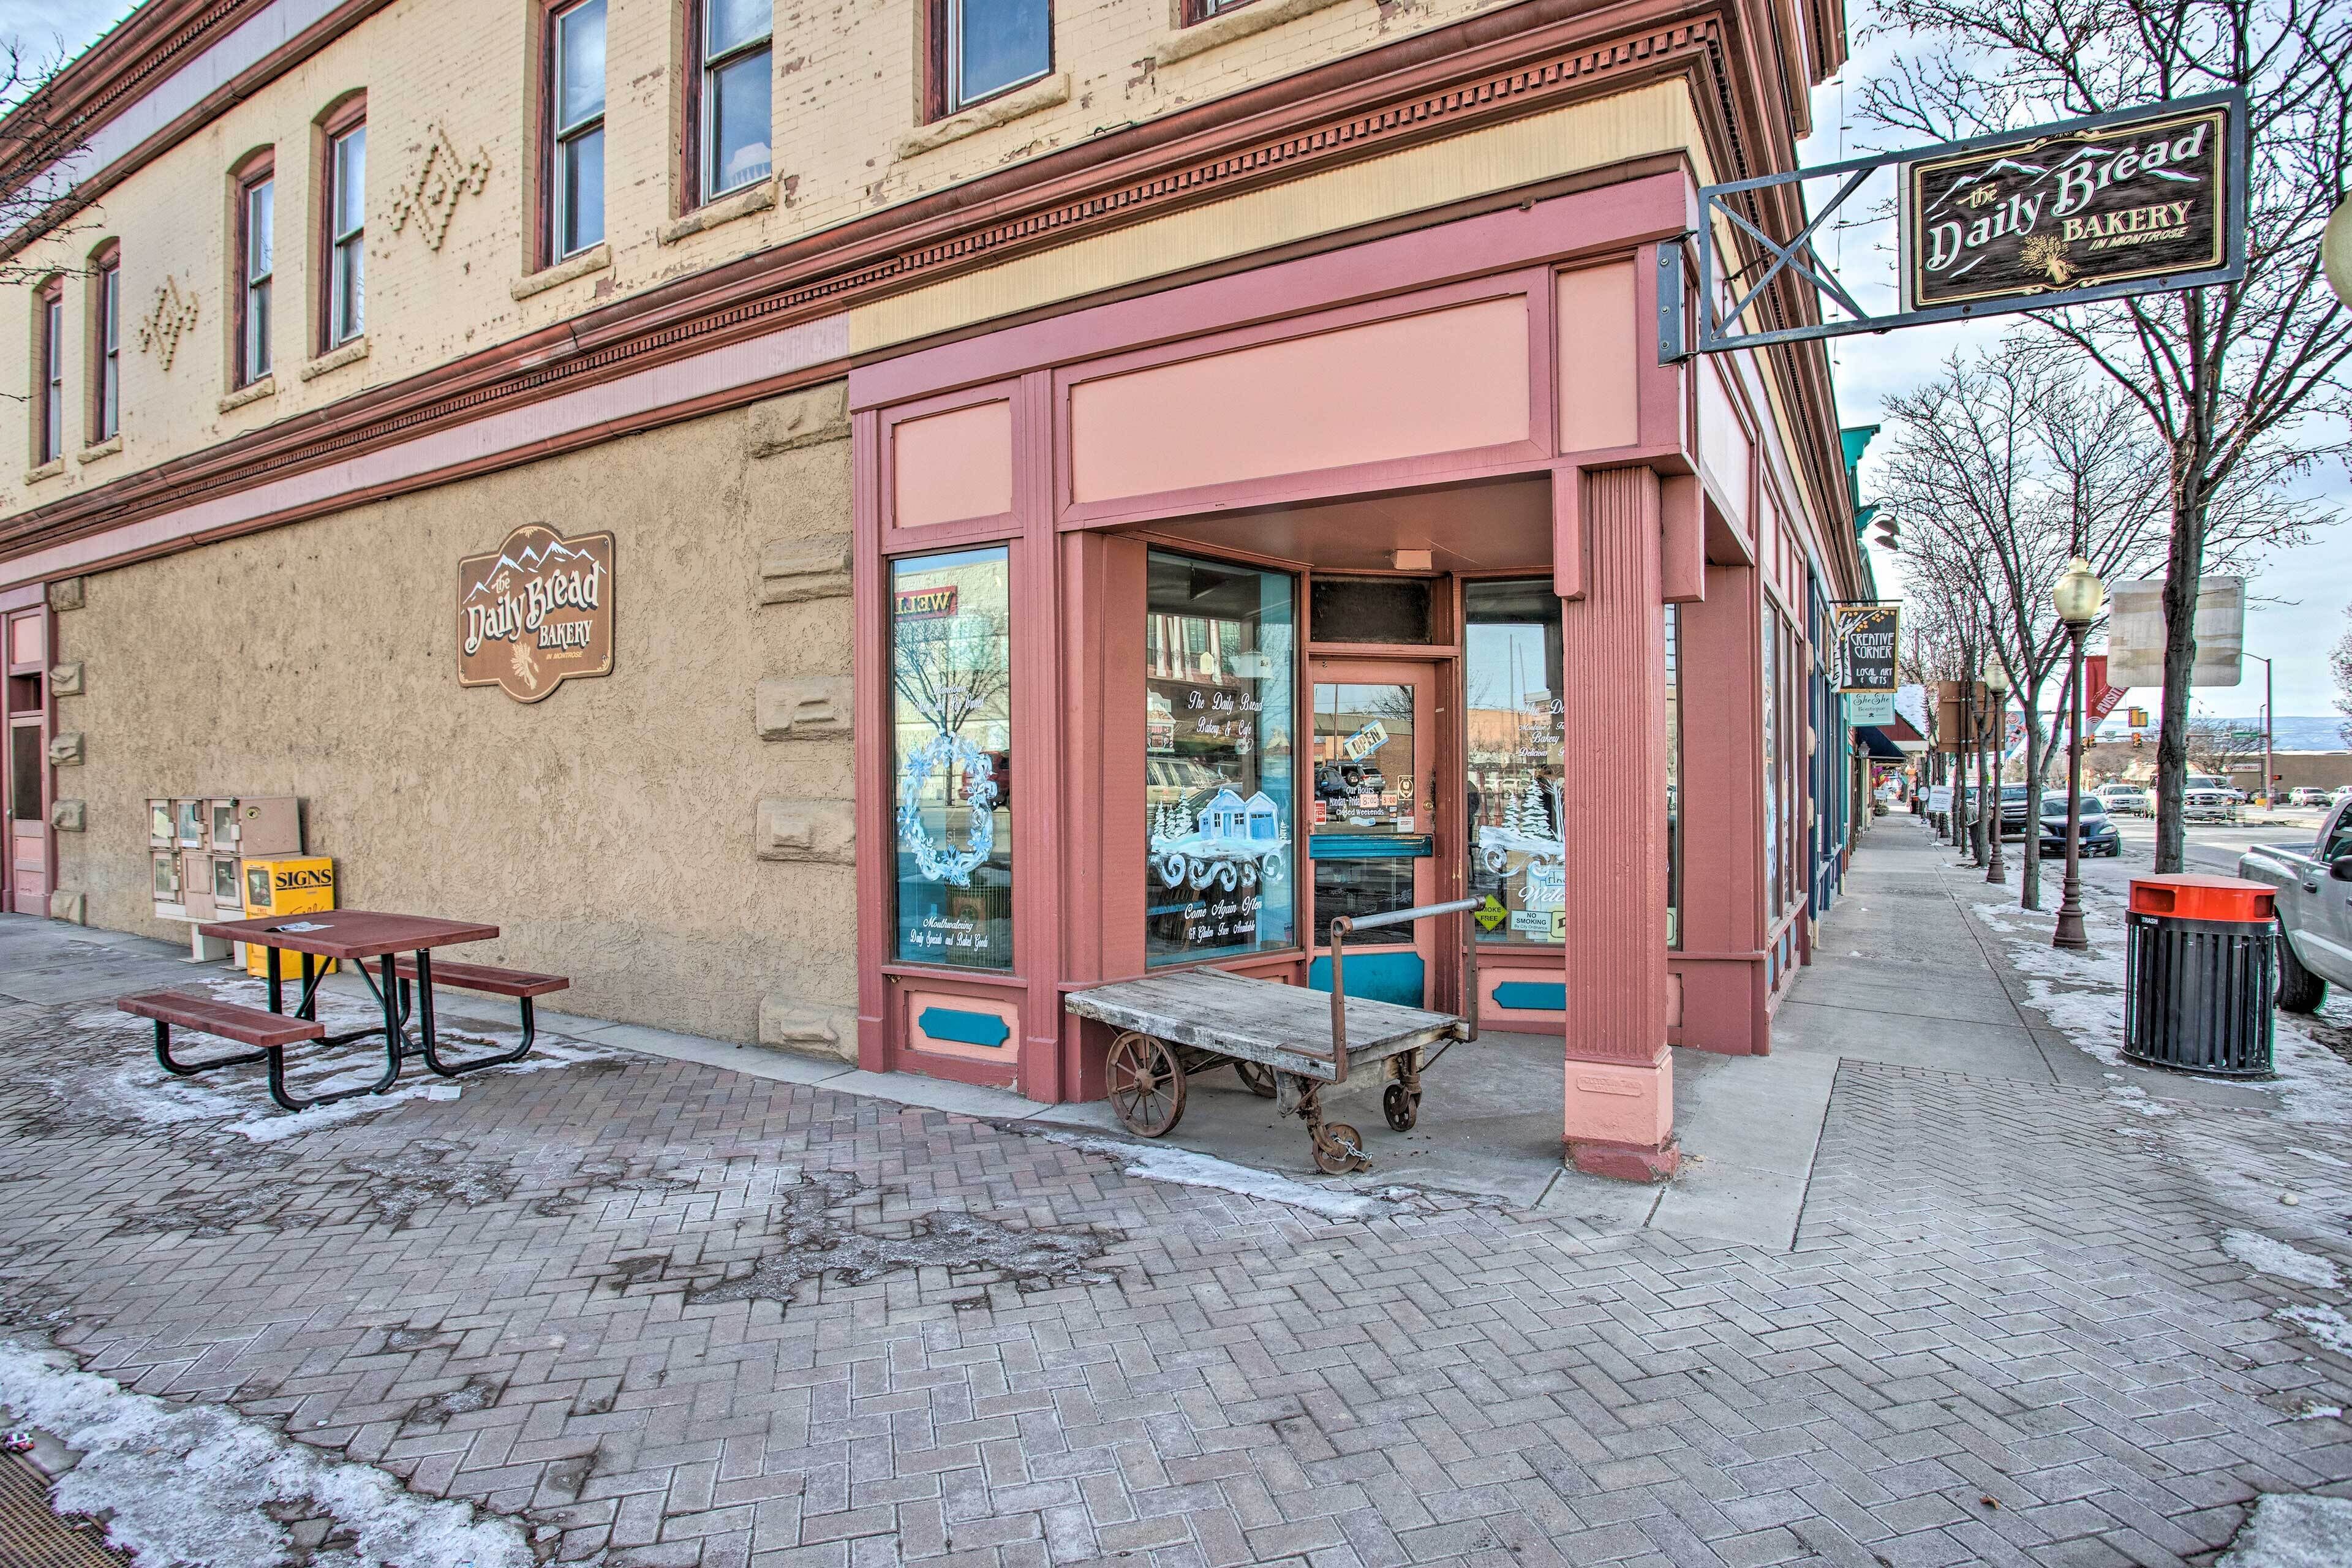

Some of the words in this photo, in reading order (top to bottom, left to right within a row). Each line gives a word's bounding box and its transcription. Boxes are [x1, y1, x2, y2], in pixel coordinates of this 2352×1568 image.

[1925, 191, 2046, 271] Daily
[2050, 123, 2208, 217] Bread
[1957, 183, 1998, 208] the
[2062, 199, 2196, 243] BAKERY
[2088, 238, 2108, 251] IN
[2107, 226, 2190, 248] MONTROSE
[491, 570, 511, 594] the
[464, 591, 526, 654] Daily
[525, 560, 600, 630] Bread
[538, 620, 593, 649] BAKERY
[1850, 633, 1894, 646] CREATIVE
[552, 651, 583, 660] MONTROSE
[1855, 646, 1892, 658] CORNER
[1869, 676, 1887, 685] GIFTS
[1188, 691, 1205, 709] The
[1212, 692, 1234, 715] Daily
[1240, 693, 1264, 712] Bread
[1520, 700, 1540, 716] The
[1196, 716, 1219, 738] Bakery
[1224, 721, 1231, 736] &
[1238, 719, 1251, 739] Cafe
[1352, 726, 1382, 755] OPEN
[1531, 731, 1560, 746] Bakery
[1519, 747, 1548, 757] Delicious
[1329, 796, 1346, 807] Monday
[1349, 796, 1360, 807] Frida
[1363, 797, 1377, 805] 8:00
[276, 869, 332, 888] SIGNS
[1185, 903, 1207, 919] Come
[1212, 899, 1237, 919] Again
[1242, 895, 1262, 916] Often
[923, 916, 973, 933] Mouthwatering
[1218, 922, 1229, 936] Free
[1234, 920, 1256, 934] Available
[910, 929, 924, 947] Daily
[926, 930, 943, 948] Specials
[945, 933, 954, 945] and
[957, 932, 972, 947] Baked
[974, 933, 988, 951] Goods
